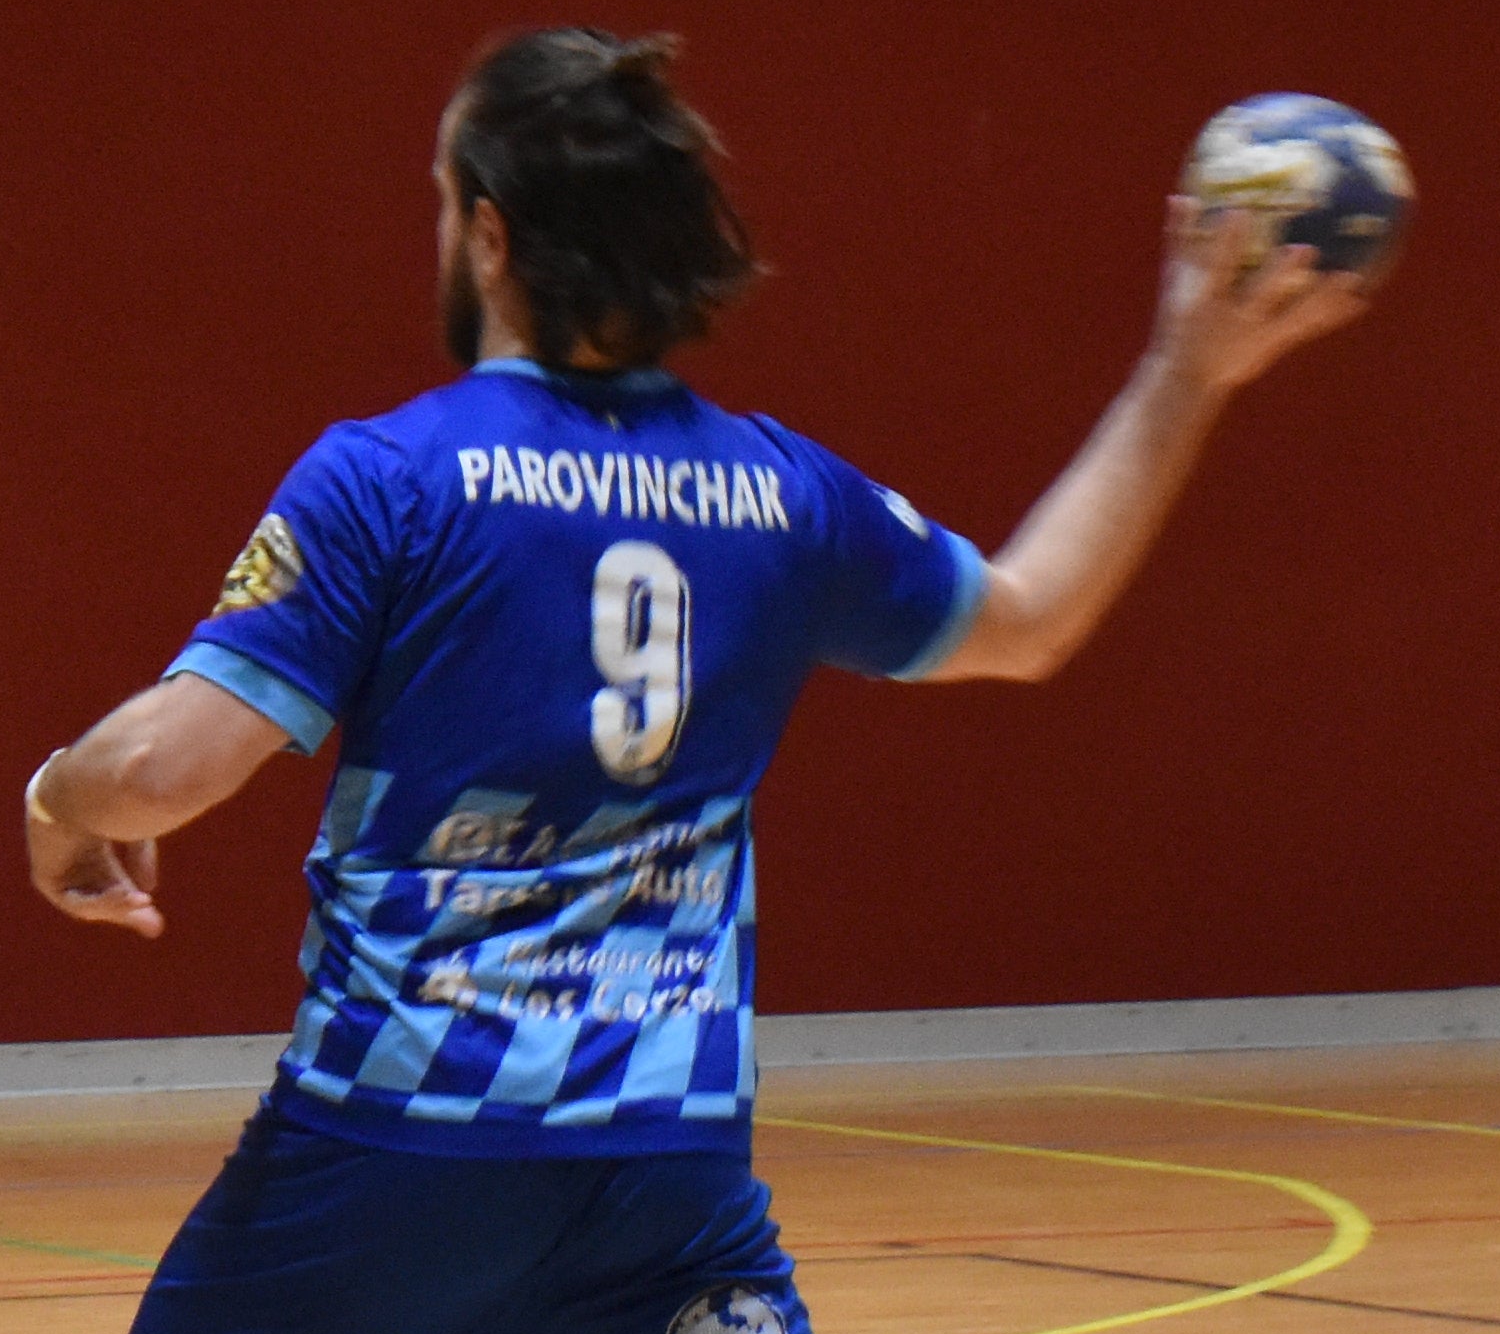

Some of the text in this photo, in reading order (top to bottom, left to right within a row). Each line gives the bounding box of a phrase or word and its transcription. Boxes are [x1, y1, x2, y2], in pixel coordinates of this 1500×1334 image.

[457, 444, 790, 532] PAROVINCHAK
[591, 539, 692, 786] 9
[592, 977, 723, 1024] Corzo
